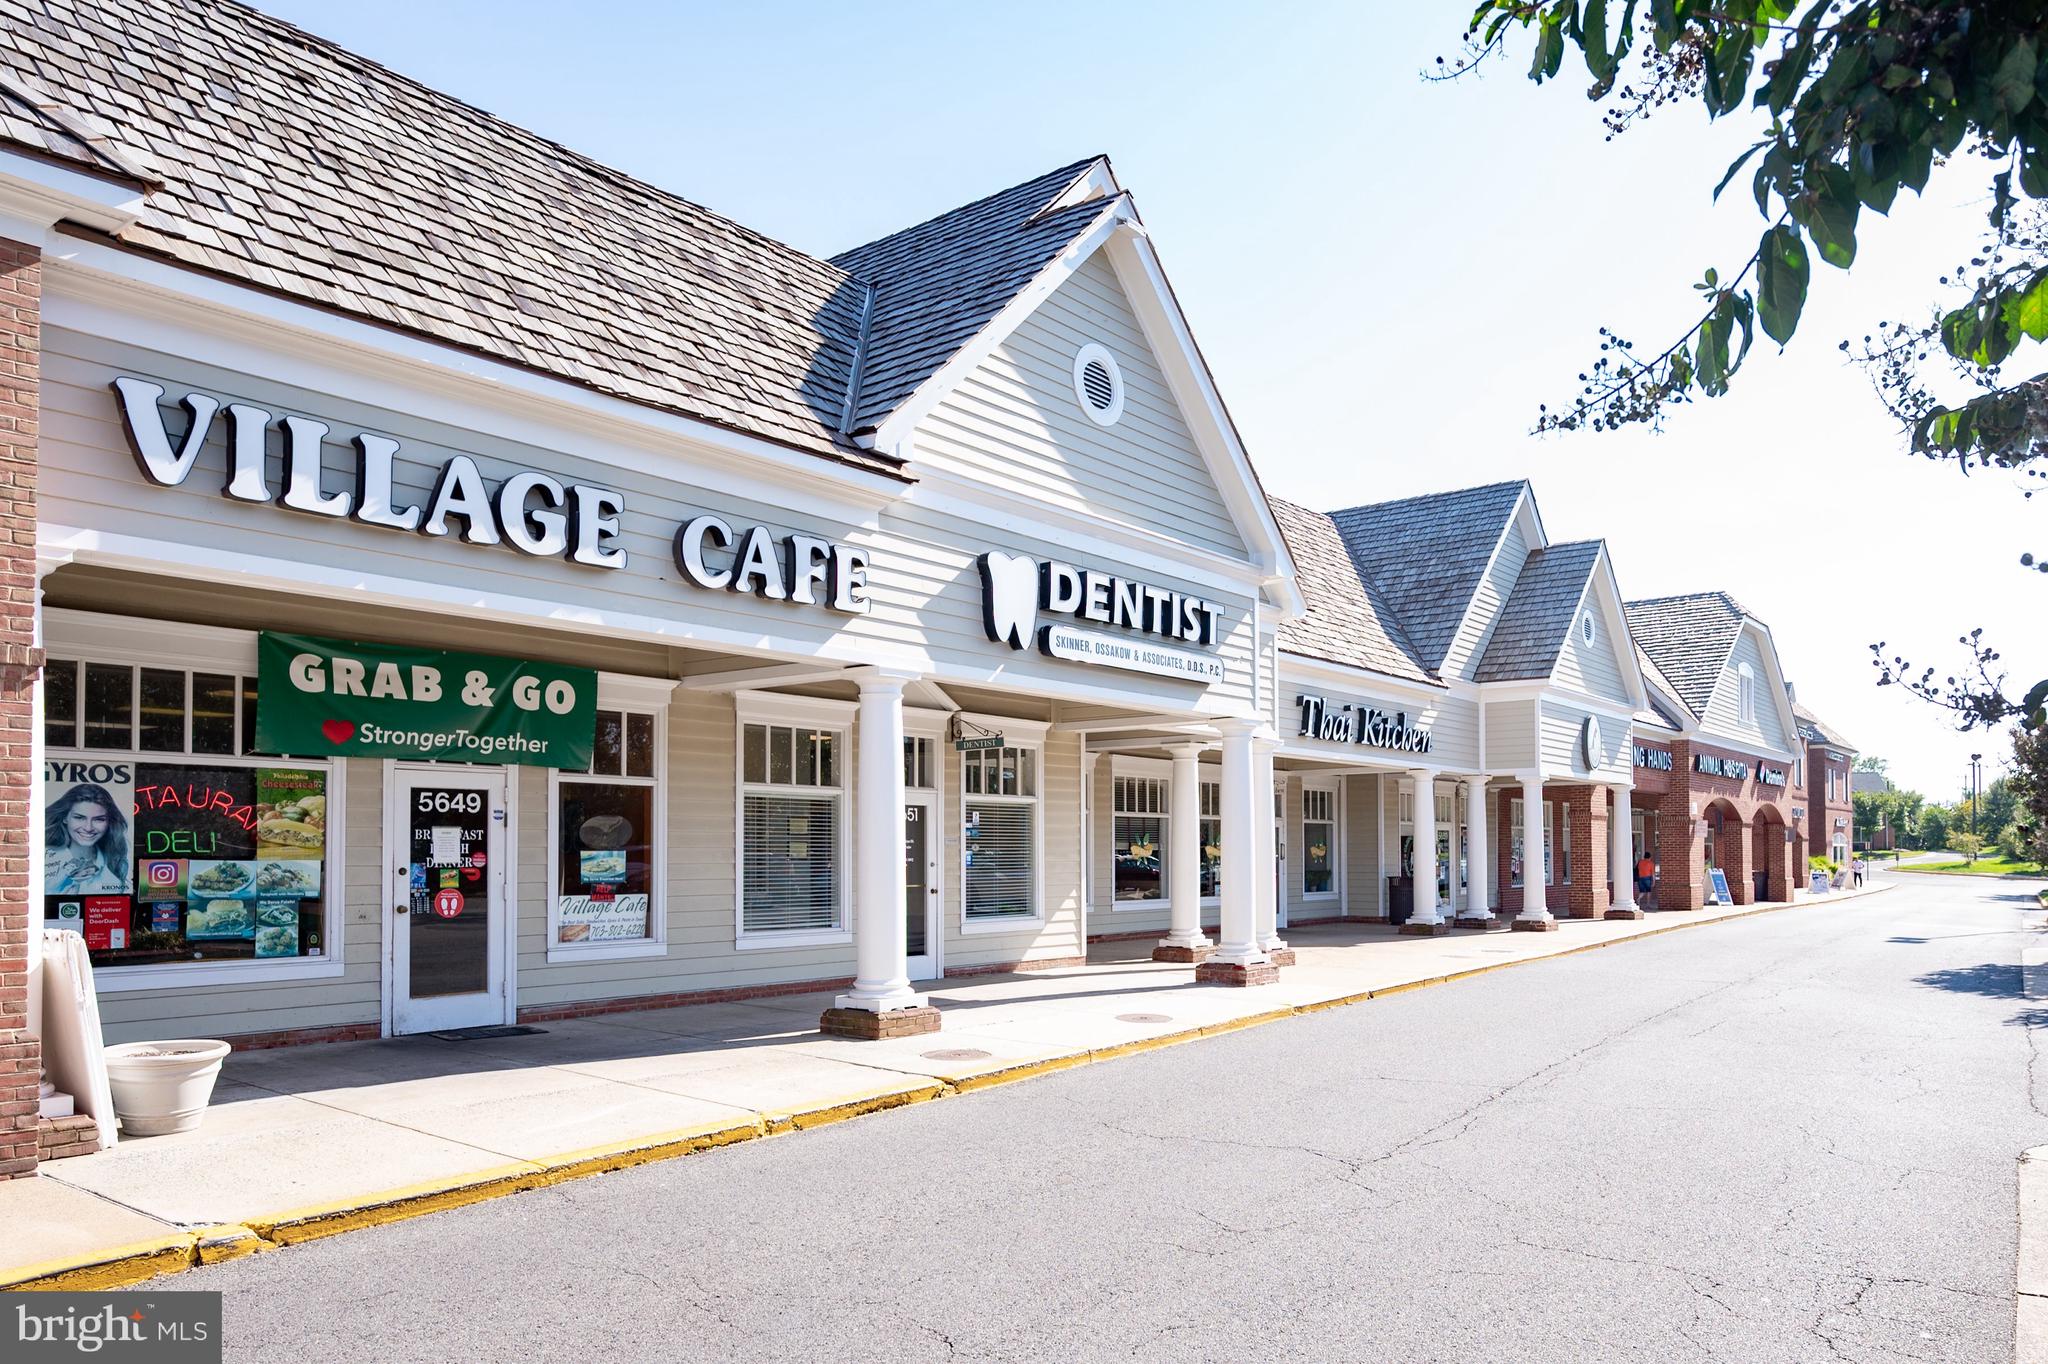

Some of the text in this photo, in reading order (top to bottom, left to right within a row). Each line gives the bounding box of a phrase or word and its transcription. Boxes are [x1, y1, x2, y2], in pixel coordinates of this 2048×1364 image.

[108, 375, 871, 614] VILLAGE CAFE
[1042, 561, 1226, 645] DENTIST
[1056, 635, 1093, 654] SKINNER,
[1095, 642, 1131, 659] OSSAKOW
[1133, 653, 1139, 662] &
[1142, 652, 1186, 672] ASSOCIATES,
[1209, 664, 1221, 677] P.C.
[289, 653, 577, 715] GRAB & GO
[1297, 695, 1433, 753] Thai Kitchen
[359, 723, 548, 755] StrongerTogether
[963, 739, 997, 749] DENTIST
[1648, 750, 1673, 771] HANDS
[1699, 754, 1723, 776] ANIMAL
[418, 792, 481, 813] 5649
[147, 831, 216, 853] DELI
[415, 829, 484, 840] BRAST
[560, 896, 647, 919] Village Cafe
